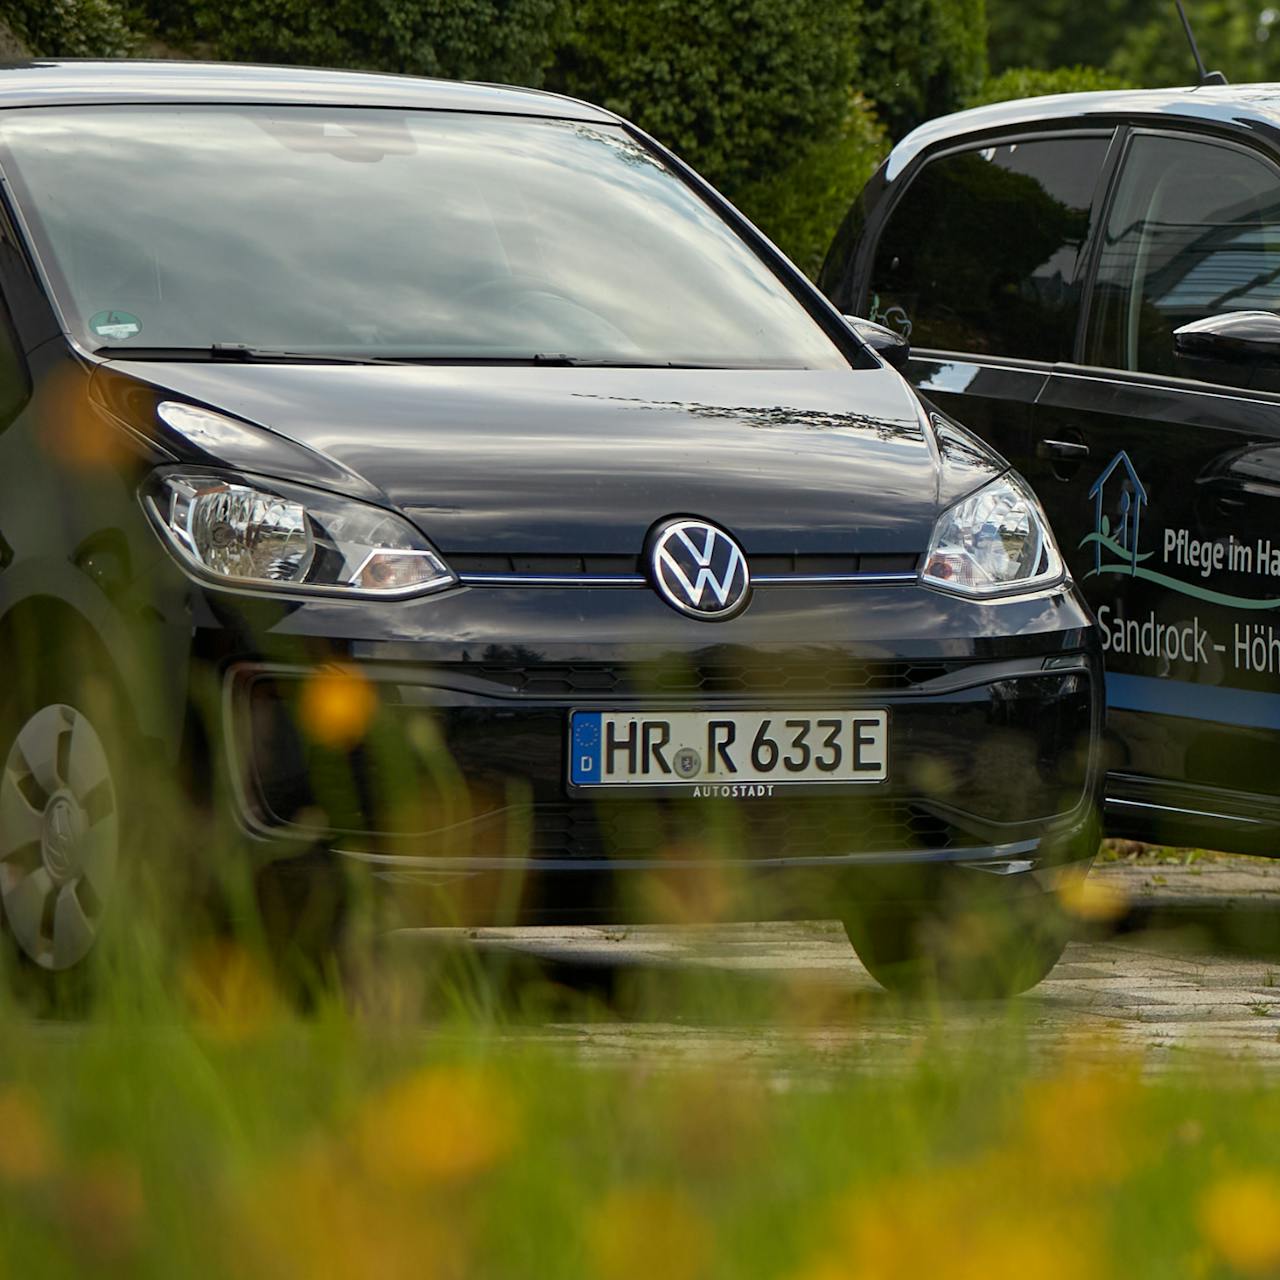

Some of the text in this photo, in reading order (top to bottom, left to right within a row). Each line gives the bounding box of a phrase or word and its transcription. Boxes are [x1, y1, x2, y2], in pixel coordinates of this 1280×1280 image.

[656, 525, 742, 607] VW
[1164, 528, 1223, 578] Pflege
[1228, 535, 1252, 573] im
[1098, 605, 1208, 664] Sandrock
[580, 756, 593, 772] D
[606, 721, 672, 774] HR
[708, 720, 738, 773] R
[693, 785, 774, 798] AUTOSTADT
